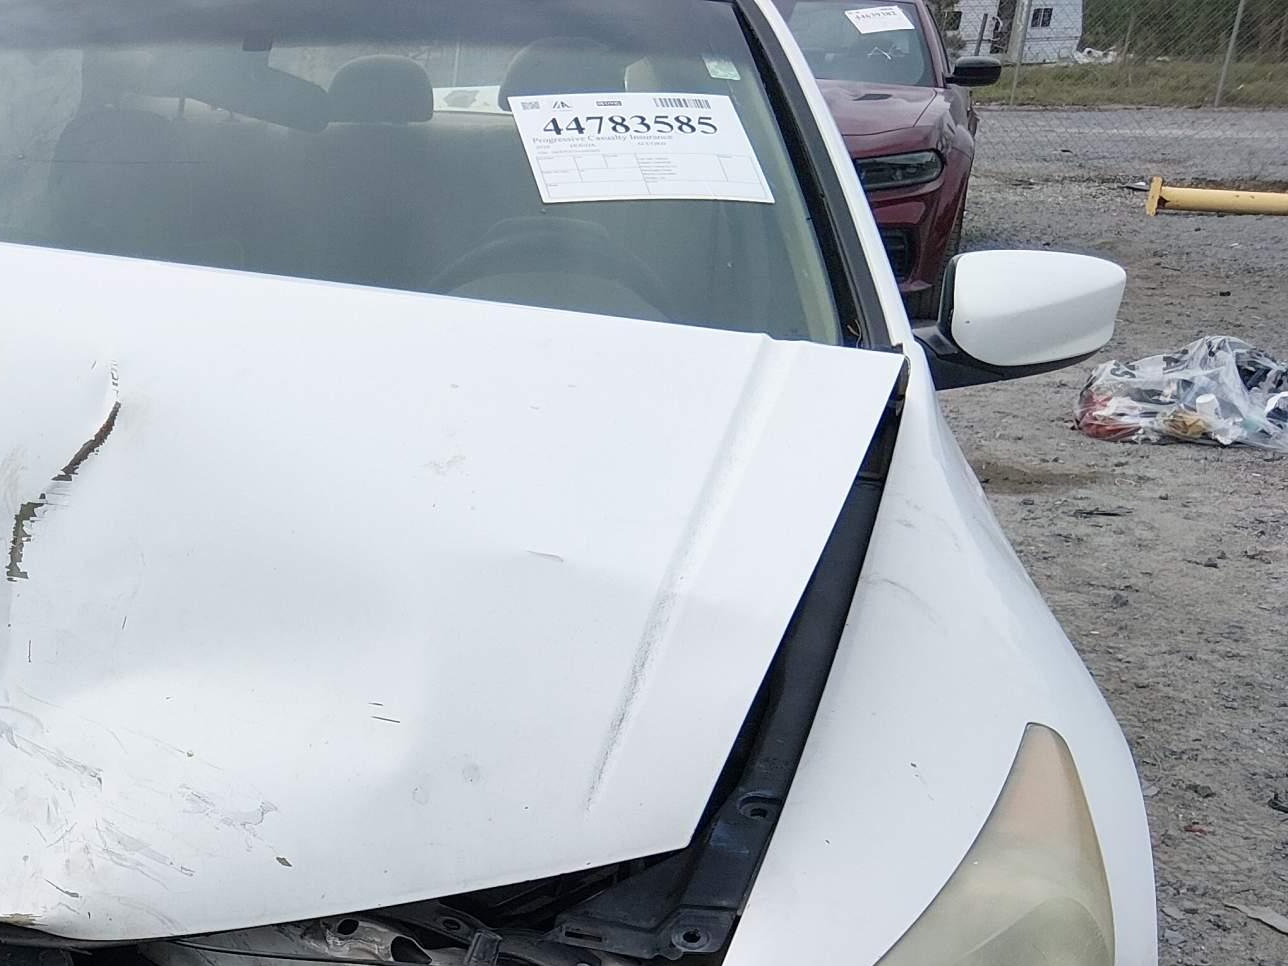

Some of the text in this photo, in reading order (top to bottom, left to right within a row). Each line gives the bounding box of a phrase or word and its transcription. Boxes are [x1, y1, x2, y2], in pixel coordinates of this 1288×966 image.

[543, 115, 718, 136] 44783585
[533, 133, 673, 144] Progressive Casualty Insurance
